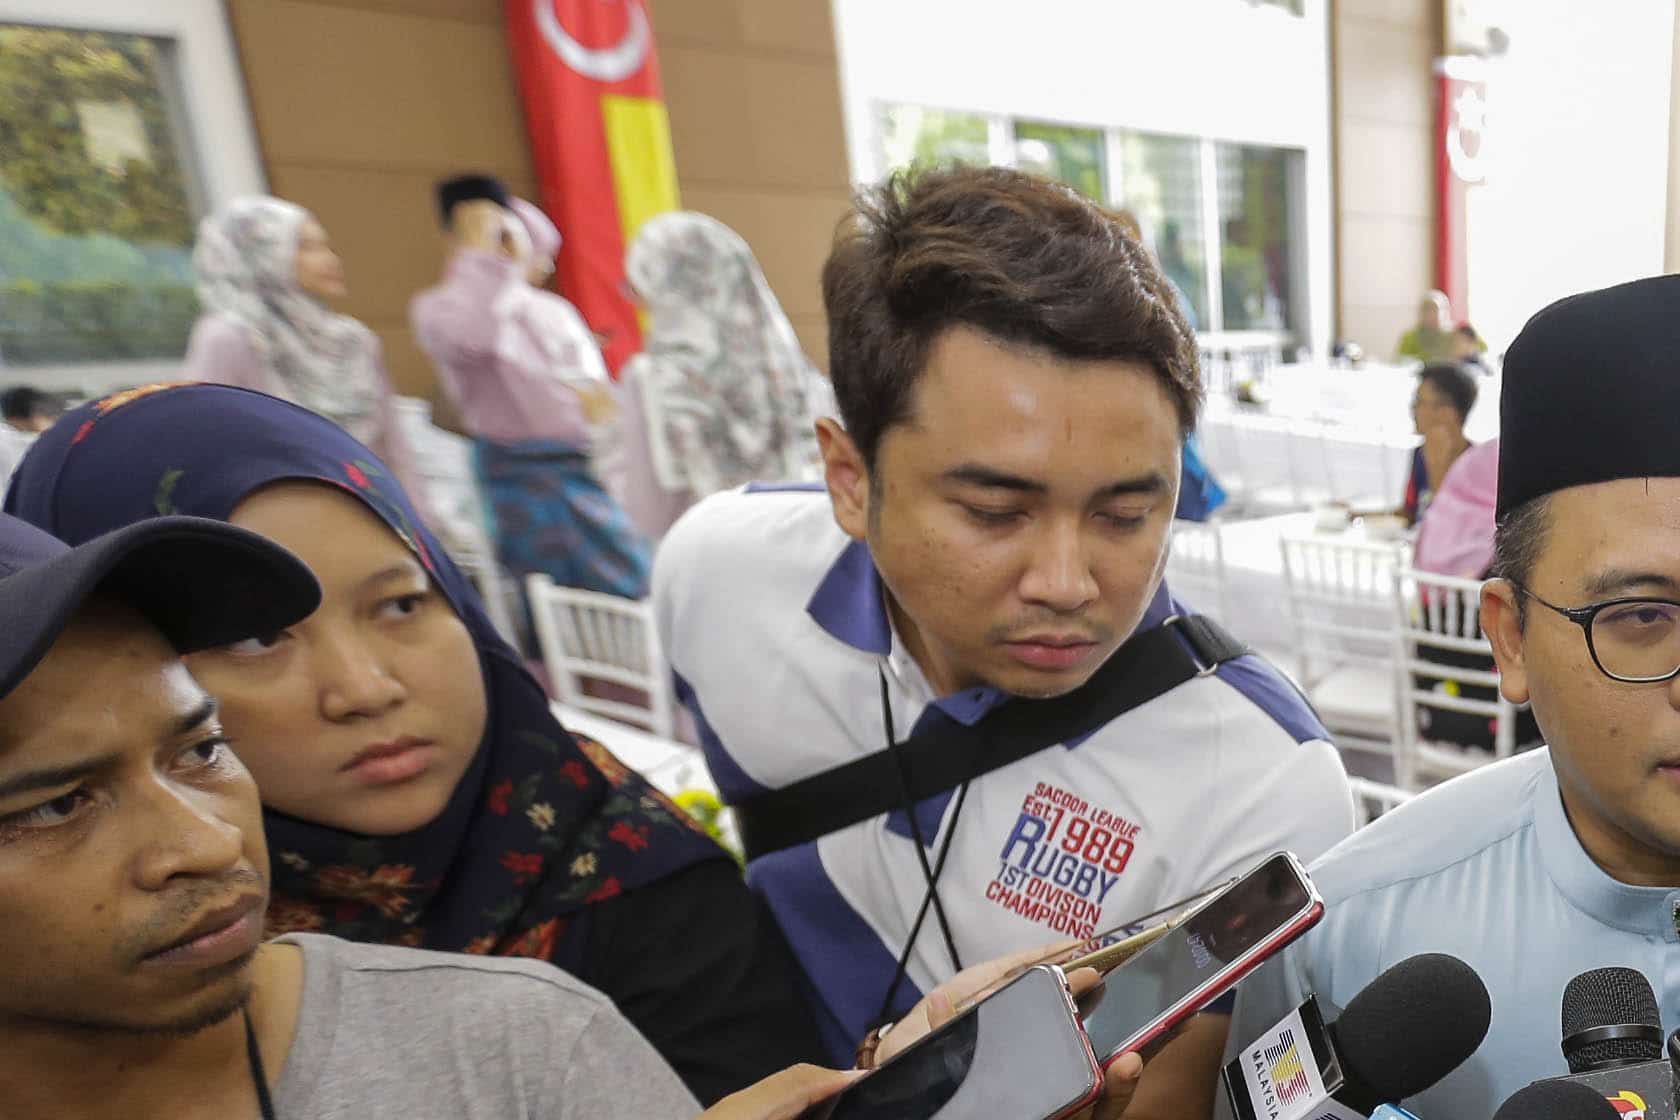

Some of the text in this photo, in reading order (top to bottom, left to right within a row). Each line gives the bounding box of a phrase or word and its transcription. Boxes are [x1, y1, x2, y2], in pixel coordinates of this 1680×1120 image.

[1034, 781, 1142, 840] SACOOR LEAGUE
[1045, 807, 1136, 875] 1989
[1000, 812, 1119, 904] RUGBY
[985, 880, 1095, 941] CHAMPIONS
[997, 861, 1102, 926] 1ST DIVISON
